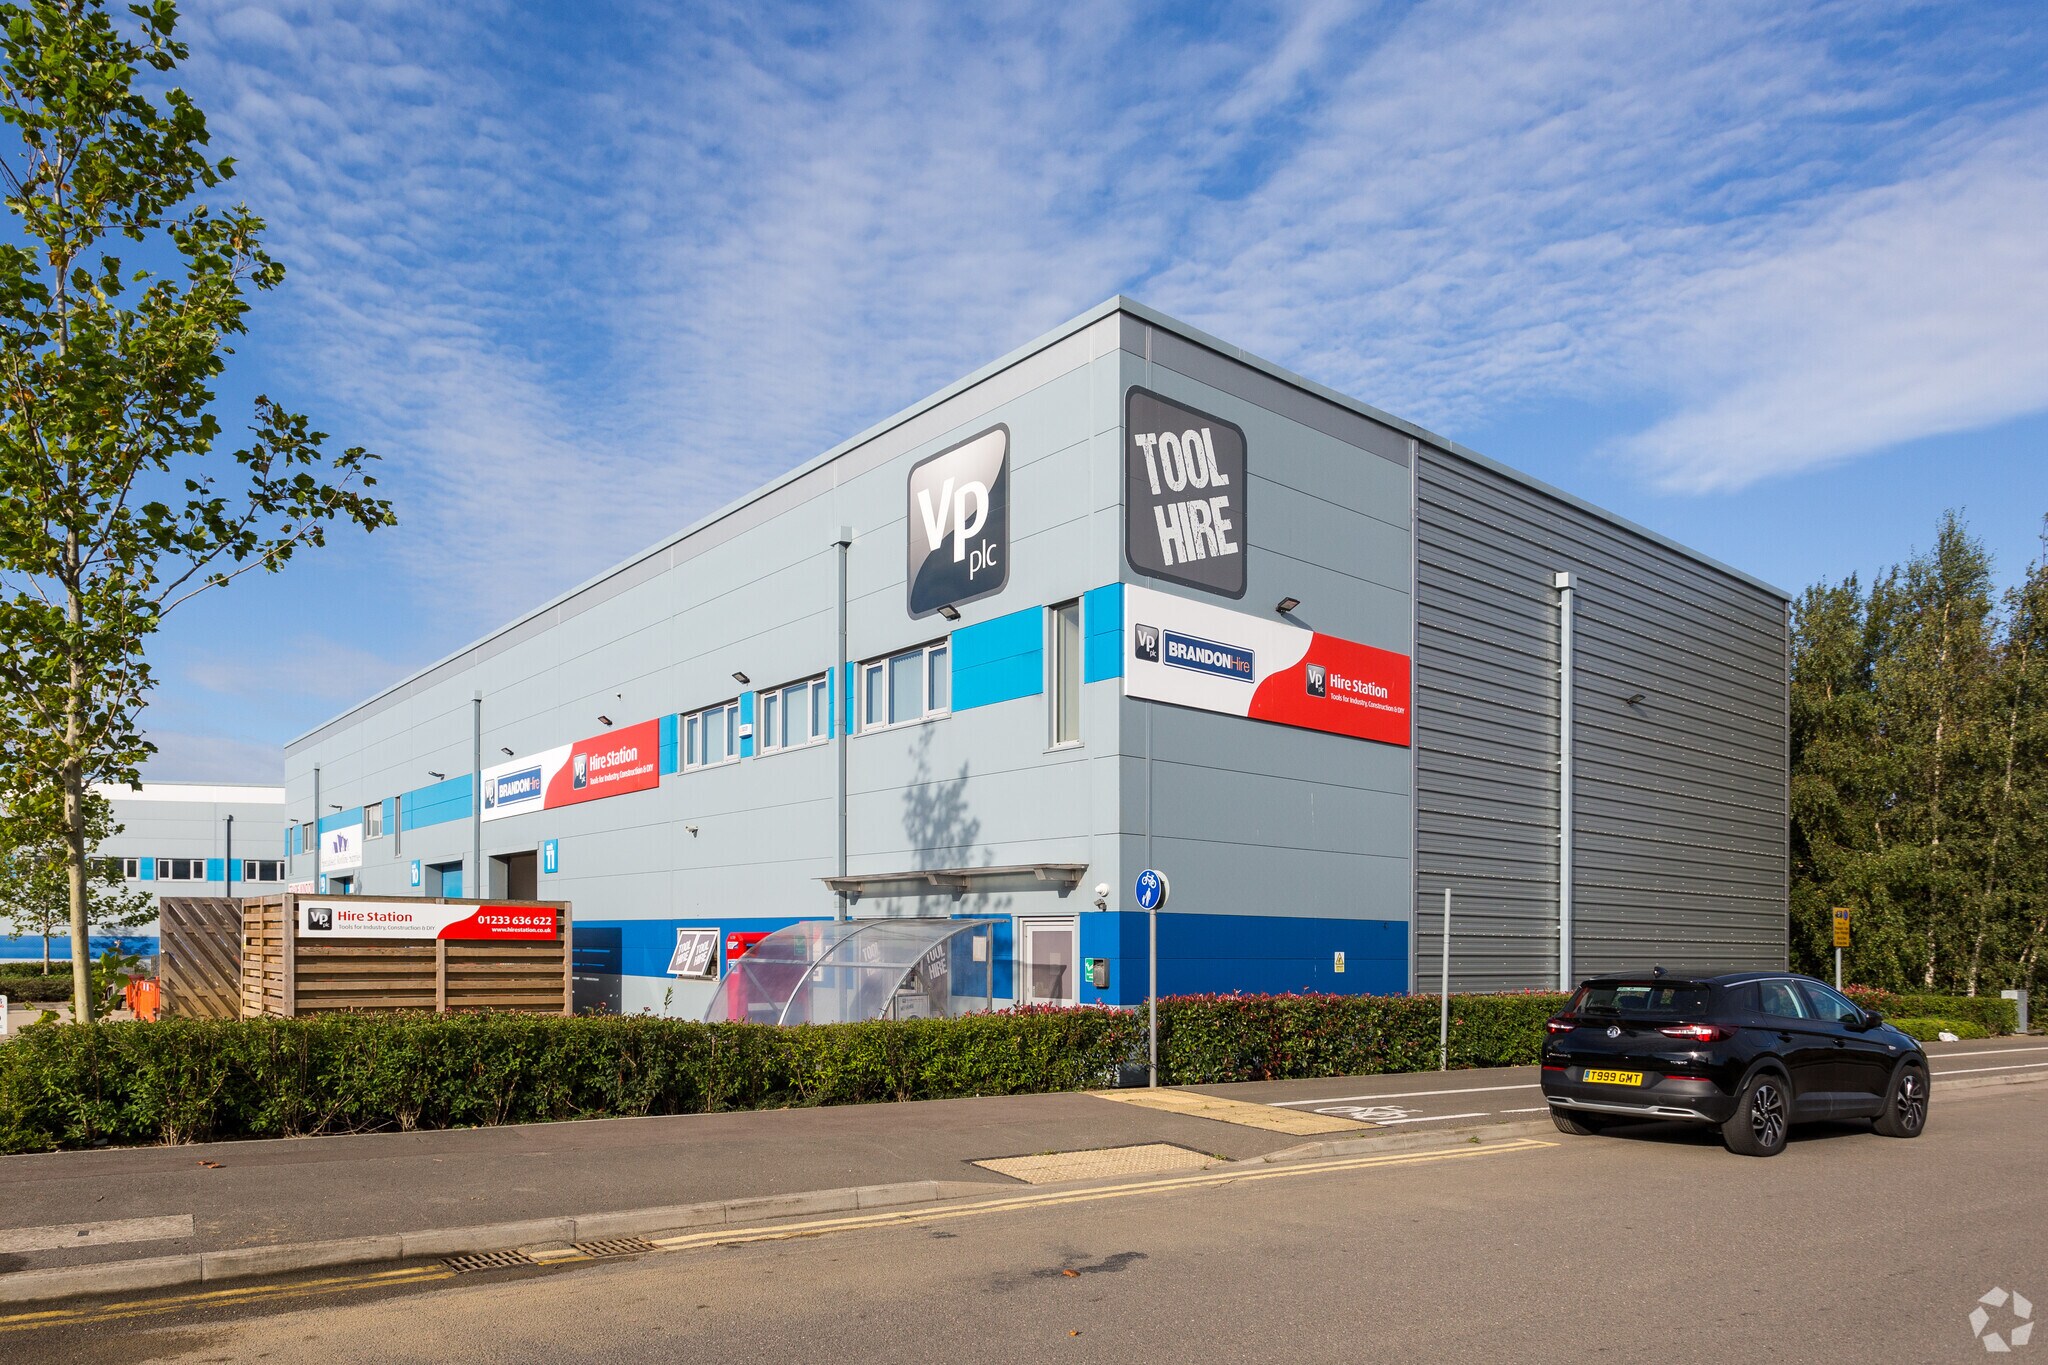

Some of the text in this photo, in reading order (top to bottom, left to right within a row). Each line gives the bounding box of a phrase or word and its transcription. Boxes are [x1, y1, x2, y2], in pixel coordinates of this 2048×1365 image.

[1134, 427, 1230, 495] TOOL
[917, 476, 989, 563] Vp
[1153, 495, 1239, 566] HIRE
[969, 539, 997, 581] plc
[1137, 630, 1155, 652] Vp
[1168, 641, 1250, 673] BRANDONHire
[1308, 669, 1323, 688] Vp
[1330, 673, 1388, 699] Hire Station
[1330, 692, 1342, 702] Tools
[1368, 701, 1394, 712] Construction
[590, 746, 638, 772] Hire Station
[574, 762, 585, 779] Vp
[620, 766, 643, 778] Construction
[546, 850, 554, 870] 11
[310, 911, 328, 924] Vp
[337, 910, 413, 922] Hire Station
[478, 915, 552, 925] 01233 636 622
[928, 958, 948, 979] HIRE
[1591, 1071, 1640, 1083] T999 GMT
